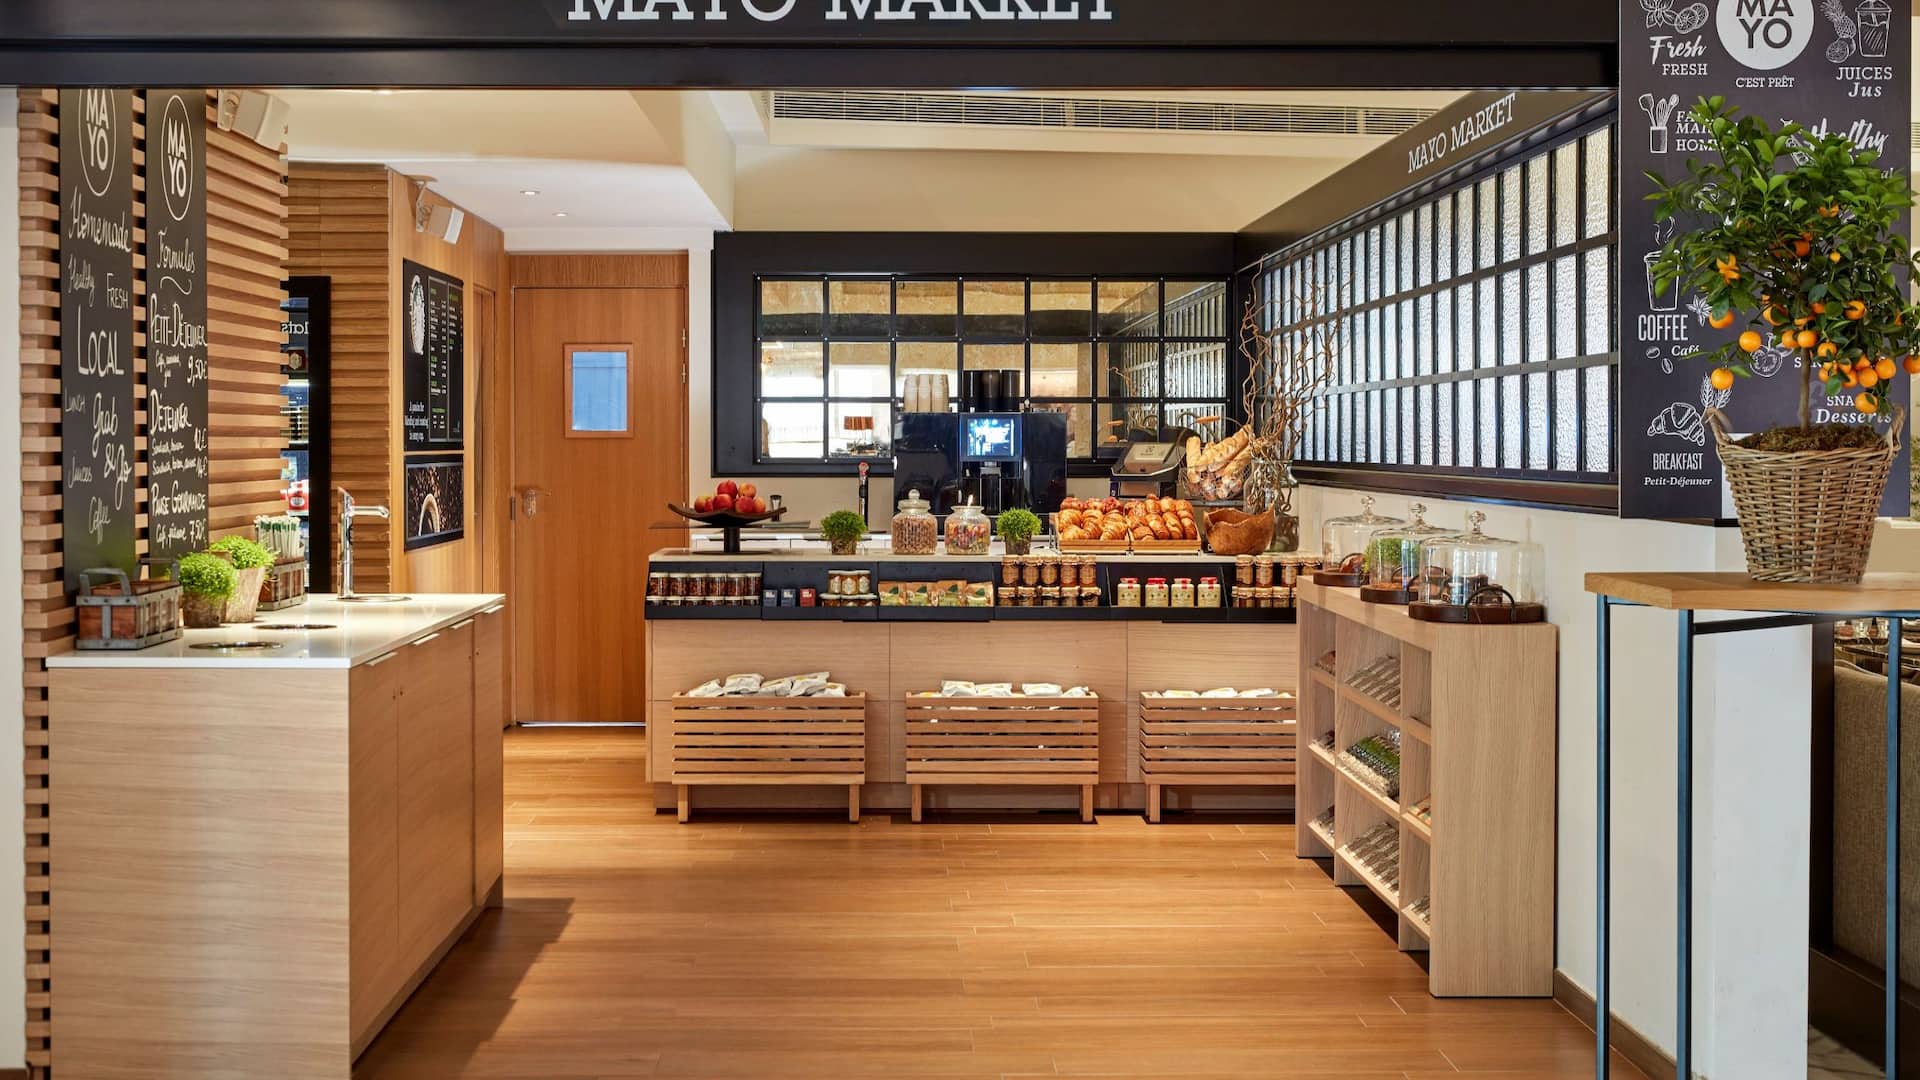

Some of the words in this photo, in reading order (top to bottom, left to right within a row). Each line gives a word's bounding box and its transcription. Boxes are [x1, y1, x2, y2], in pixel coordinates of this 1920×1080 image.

[1649, 34, 1707, 65] Fresh
[1739, 17, 1793, 49] YO
[1662, 63, 1708, 76] FRESH
[1768, 75, 1795, 88] PRÊT
[1836, 66, 1893, 81] JUICES
[1848, 81, 1882, 98] Jus
[85, 88, 109, 130] MA
[87, 122, 109, 171] YO
[167, 117, 188, 161] MA
[1407, 131, 1447, 174] MAYO
[1450, 91, 1516, 152] MARKET
[168, 154, 188, 198] YO
[68, 185, 132, 253] Homemade
[156, 227, 196, 274] Formules
[106, 272, 129, 310] FRESH
[77, 304, 125, 378] LOCAL
[1638, 314, 1689, 341] COFFEE
[1652, 453, 1704, 471] BREAKFAST
[1644, 476, 1713, 488] Petit-Déjeuner
